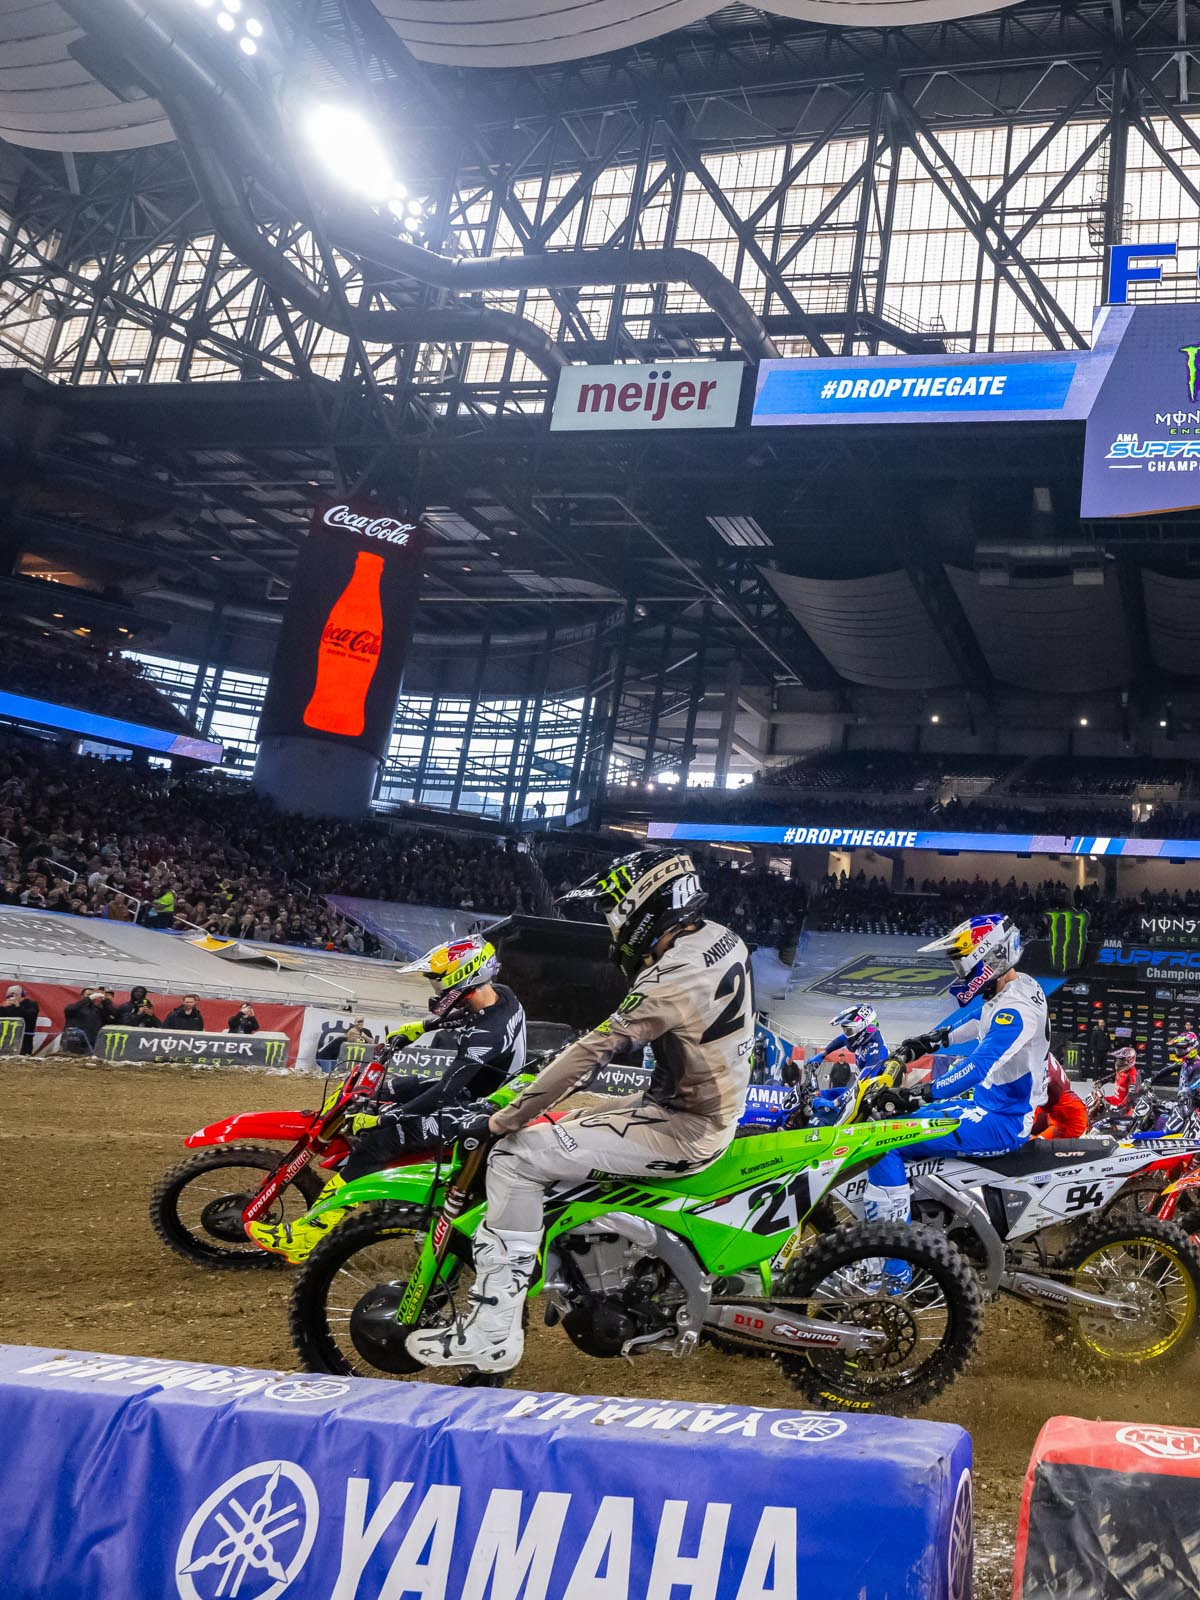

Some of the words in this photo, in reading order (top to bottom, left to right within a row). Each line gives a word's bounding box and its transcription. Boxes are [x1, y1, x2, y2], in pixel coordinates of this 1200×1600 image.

[576, 371, 717, 421] meijer
[820, 375, 1008, 399] #DROPTHEGATE
[1117, 433, 1138, 442] AMA
[323, 505, 416, 546] Coca-Cola
[784, 827, 917, 847] #DROPTHEGATE
[972, 940, 992, 961] FOX
[1103, 939, 1123, 949] AMA
[446, 954, 487, 986] 100%
[139, 1037, 254, 1056] MONSTER
[392, 1050, 454, 1067] ONSTE
[387, 1067, 442, 1077] ENERG
[936, 1062, 976, 1090] PROGRESSIV
[876, 1131, 920, 1147] DUNLOP
[284, 1150, 311, 1184] SHOWA
[740, 1155, 784, 1175] Kawasaki
[1118, 1153, 1152, 1163] DUNLOP
[248, 1182, 277, 1219] DUNLOP
[747, 1173, 811, 1237] 21
[1064, 1183, 1104, 1213] 94
[890, 1207, 909, 1220] FOX
[733, 1313, 764, 1330] DID
[771, 1322, 841, 1349] RENTHAL
[17, 1355, 270, 1397] YAMAHA
[820, 1390, 874, 1410] DUNLOP
[504, 1395, 765, 1438] YAMAHA
[331, 1477, 798, 1600] YAMAHA
